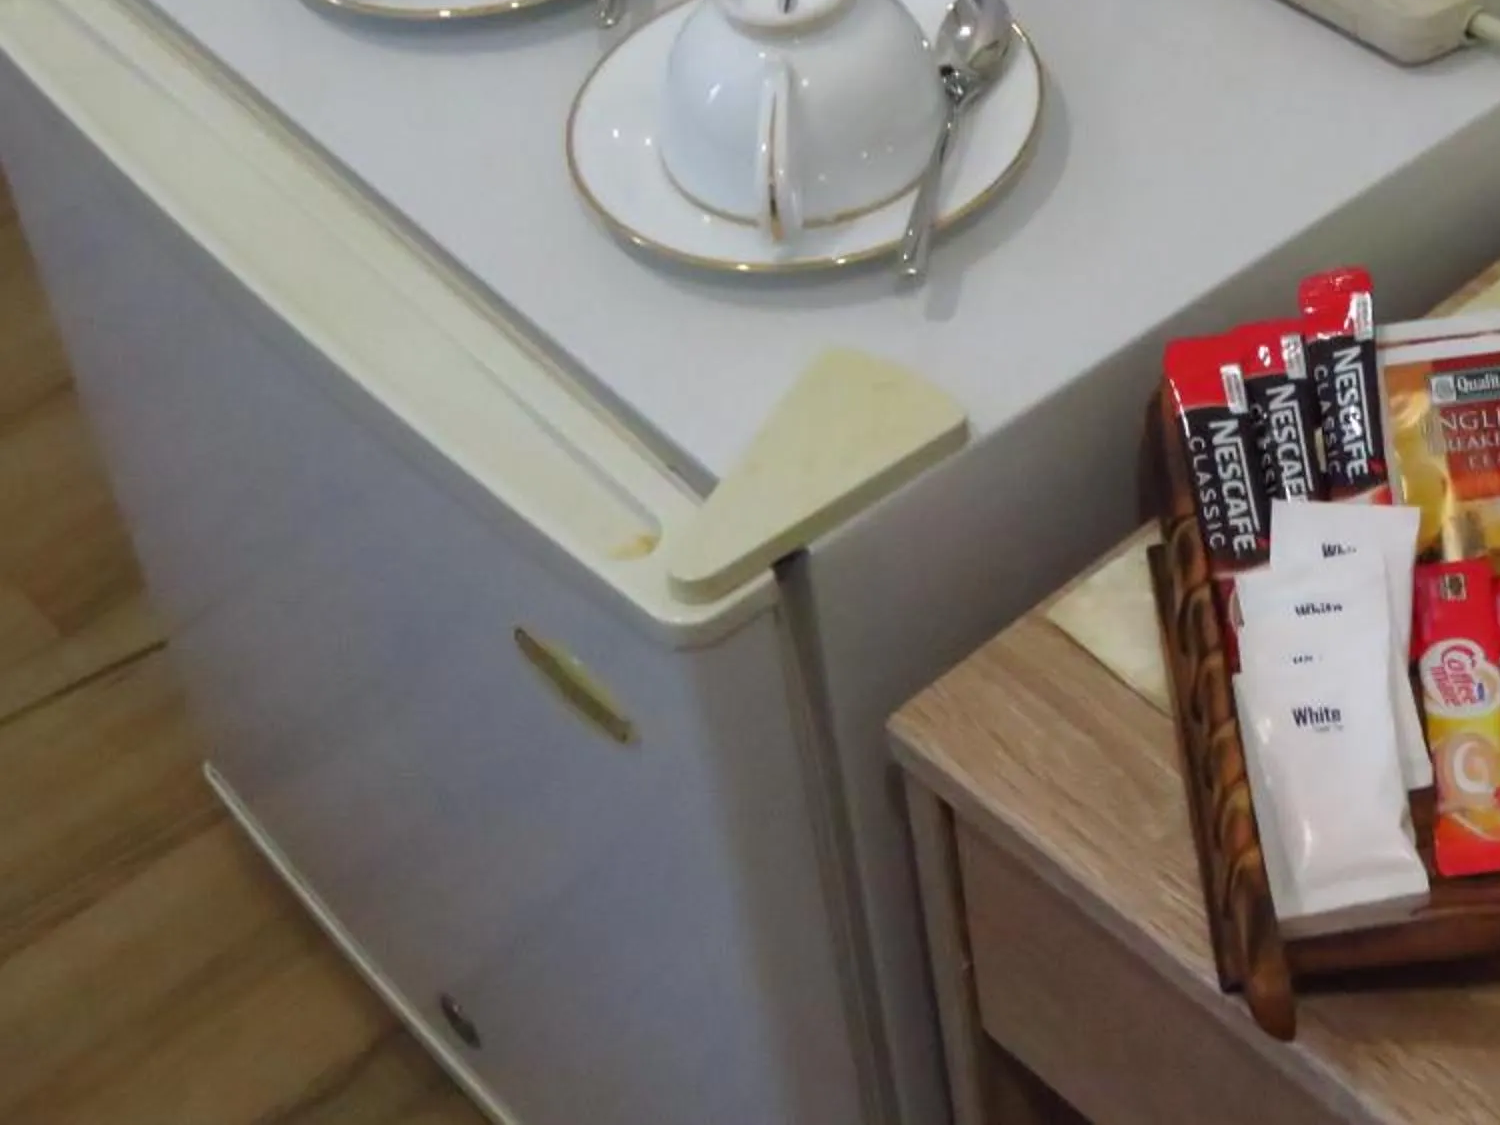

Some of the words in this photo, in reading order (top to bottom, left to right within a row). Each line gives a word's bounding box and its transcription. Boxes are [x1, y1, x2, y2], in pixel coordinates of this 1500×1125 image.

[1313, 364, 1342, 476] CLASSIC
[1189, 436, 1226, 549] CLASSIC
[1291, 705, 1342, 727] White
